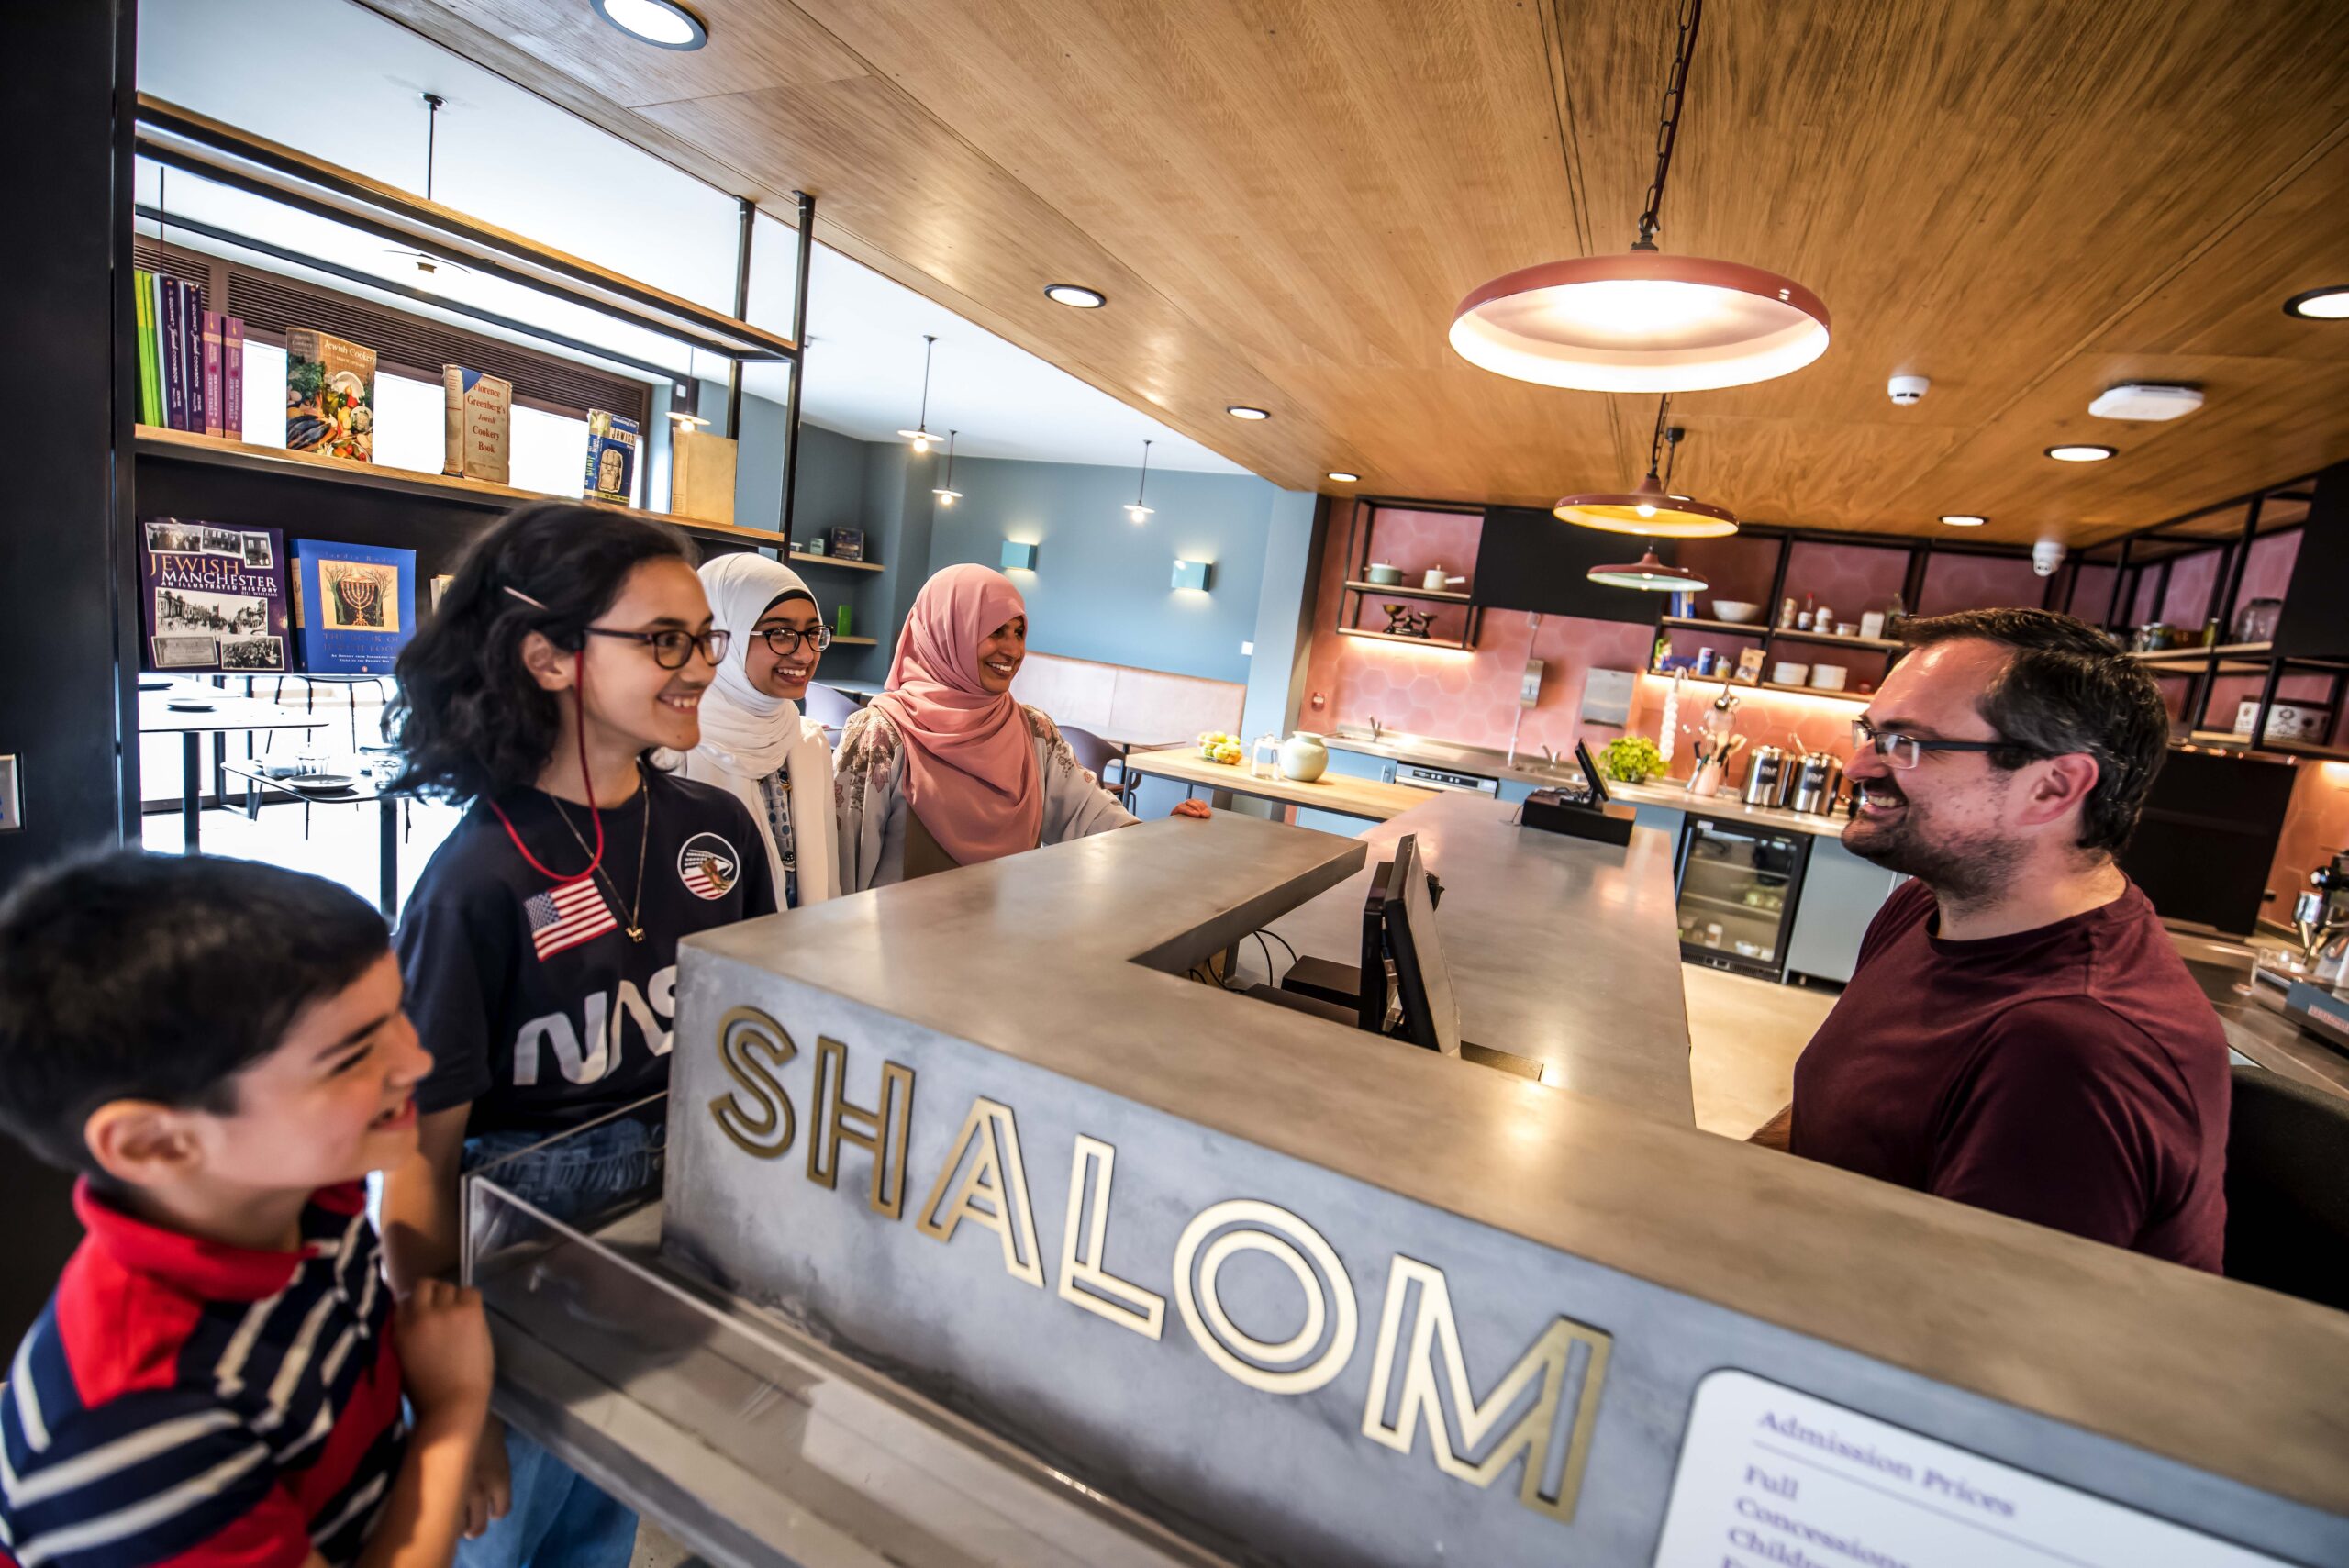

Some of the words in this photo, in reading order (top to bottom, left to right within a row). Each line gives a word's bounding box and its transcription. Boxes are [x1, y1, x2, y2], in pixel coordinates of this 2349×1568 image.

[324, 339, 348, 355] Jewish
[349, 349, 376, 365] Cookery
[473, 383, 501, 398] Florence
[466, 395, 507, 415] Greenberg's
[477, 413, 496, 425] Jewish
[472, 425, 500, 441] Cookery
[478, 441, 495, 454] Book
[150, 553, 240, 577] JEWISH
[161, 570, 277, 588] MANCHESTER
[178, 582, 238, 592] ILLUSTRATED
[708, 1005, 1612, 1525] SHALOM
[1758, 1411, 1915, 1482] Admission
[1921, 1466, 2016, 1518] Prices
[1744, 1464, 1799, 1501] Full
[1735, 1496, 1914, 1568] Concession
